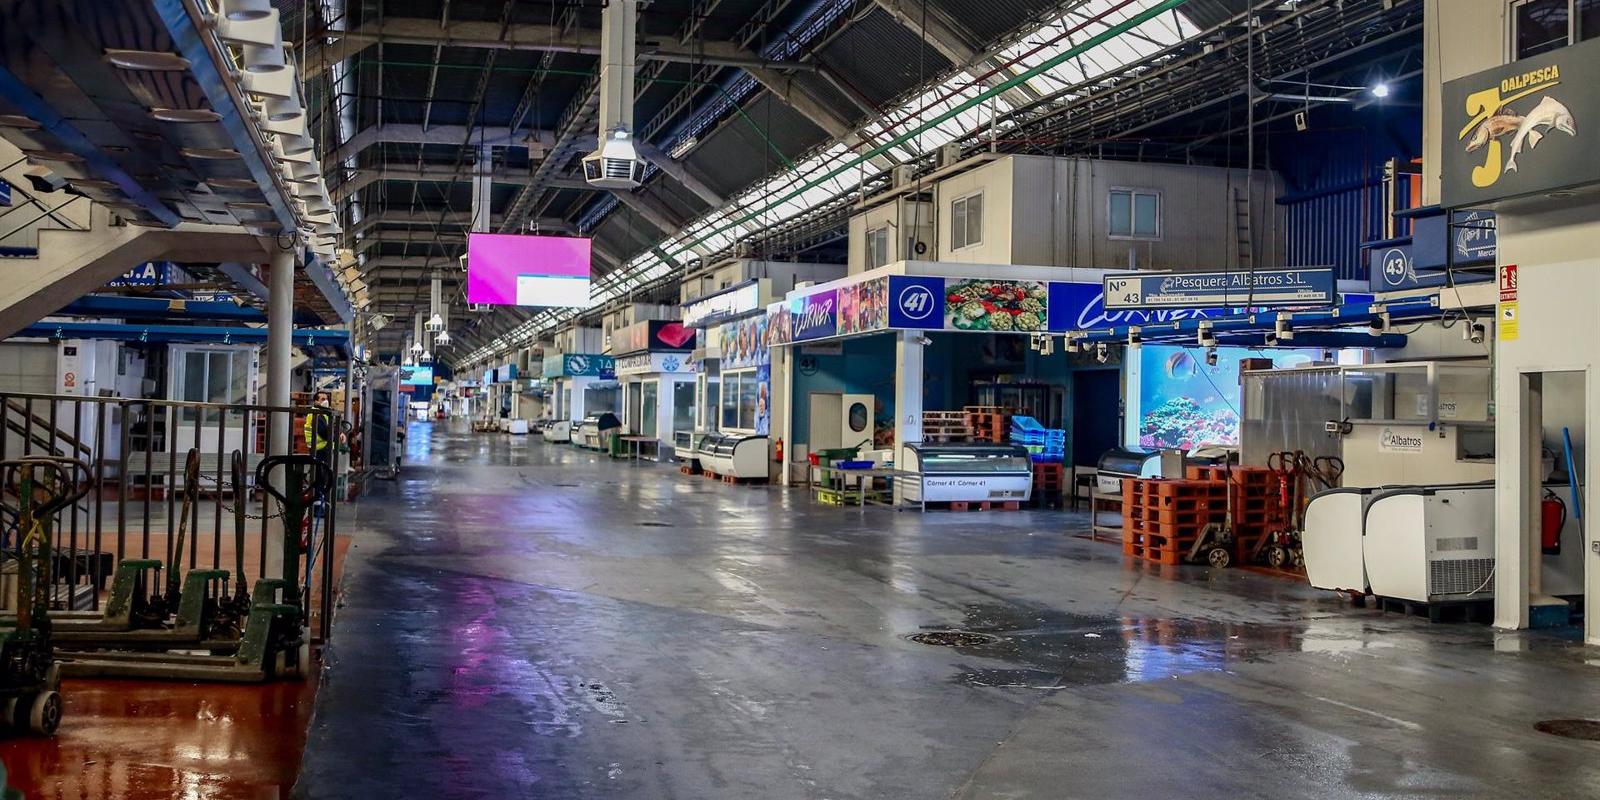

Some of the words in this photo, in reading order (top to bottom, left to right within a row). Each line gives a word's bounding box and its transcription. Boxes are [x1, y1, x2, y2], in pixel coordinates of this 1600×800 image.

[1501, 65, 1560, 92] OALPESCA
[1386, 259, 1404, 275] 43
[1175, 276, 1228, 290] Pesquera
[1231, 273, 1282, 286] Albatros
[1286, 272, 1307, 284] S.L.
[903, 292, 929, 312] 41
[1123, 293, 1140, 303] 43
[795, 298, 833, 338] CORNER
[1390, 435, 1422, 446] Albatros
